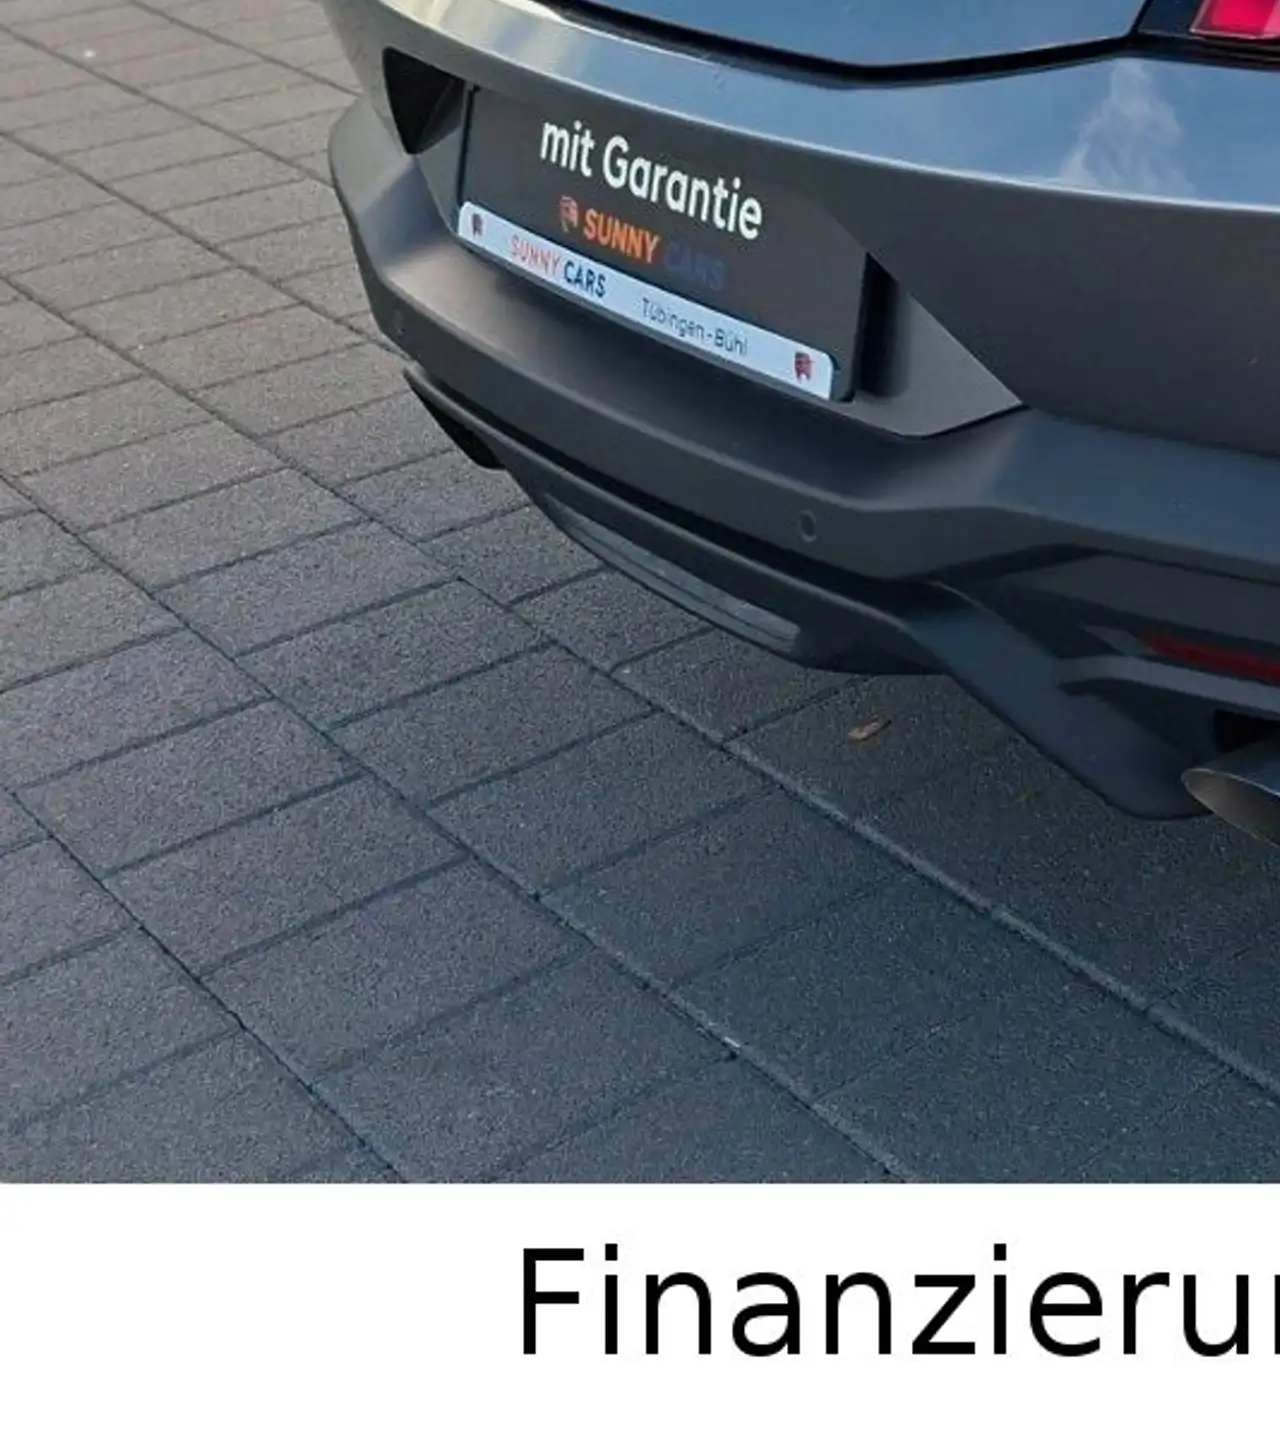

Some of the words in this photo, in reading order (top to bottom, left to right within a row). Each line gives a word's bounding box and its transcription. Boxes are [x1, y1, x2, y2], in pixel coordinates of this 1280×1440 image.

[540, 120, 595, 177] mit
[602, 134, 763, 241] Garantie
[509, 233, 562, 277] SUNNY
[563, 260, 607, 298] CARS
[583, 208, 662, 263] SUNNY
[662, 241, 725, 291] CARS
